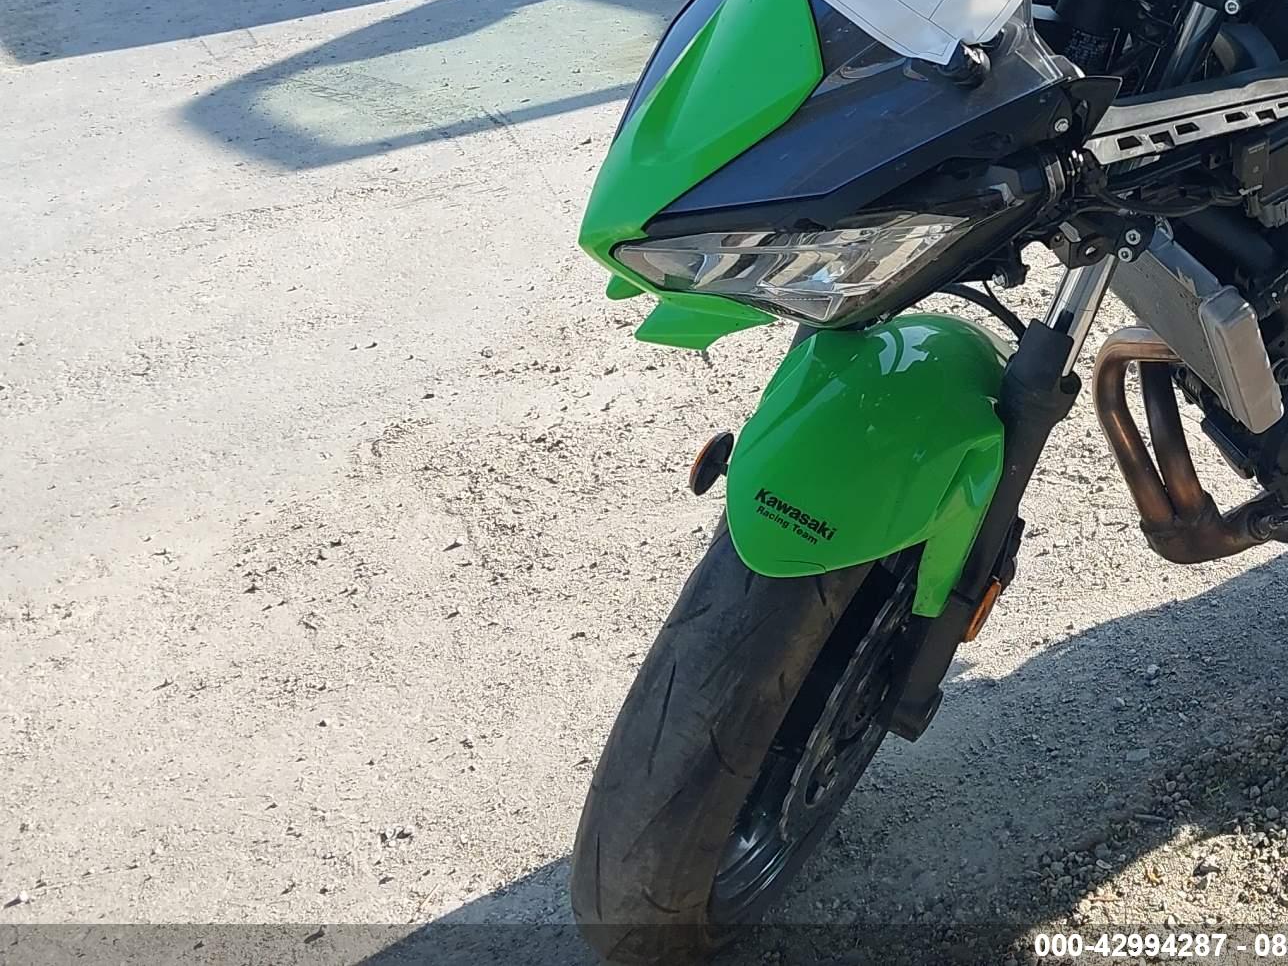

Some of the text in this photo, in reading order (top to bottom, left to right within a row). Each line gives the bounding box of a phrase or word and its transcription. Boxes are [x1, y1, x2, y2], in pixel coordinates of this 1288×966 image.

[754, 488, 837, 541] Kawasaki
[756, 505, 818, 545] Racing Team
